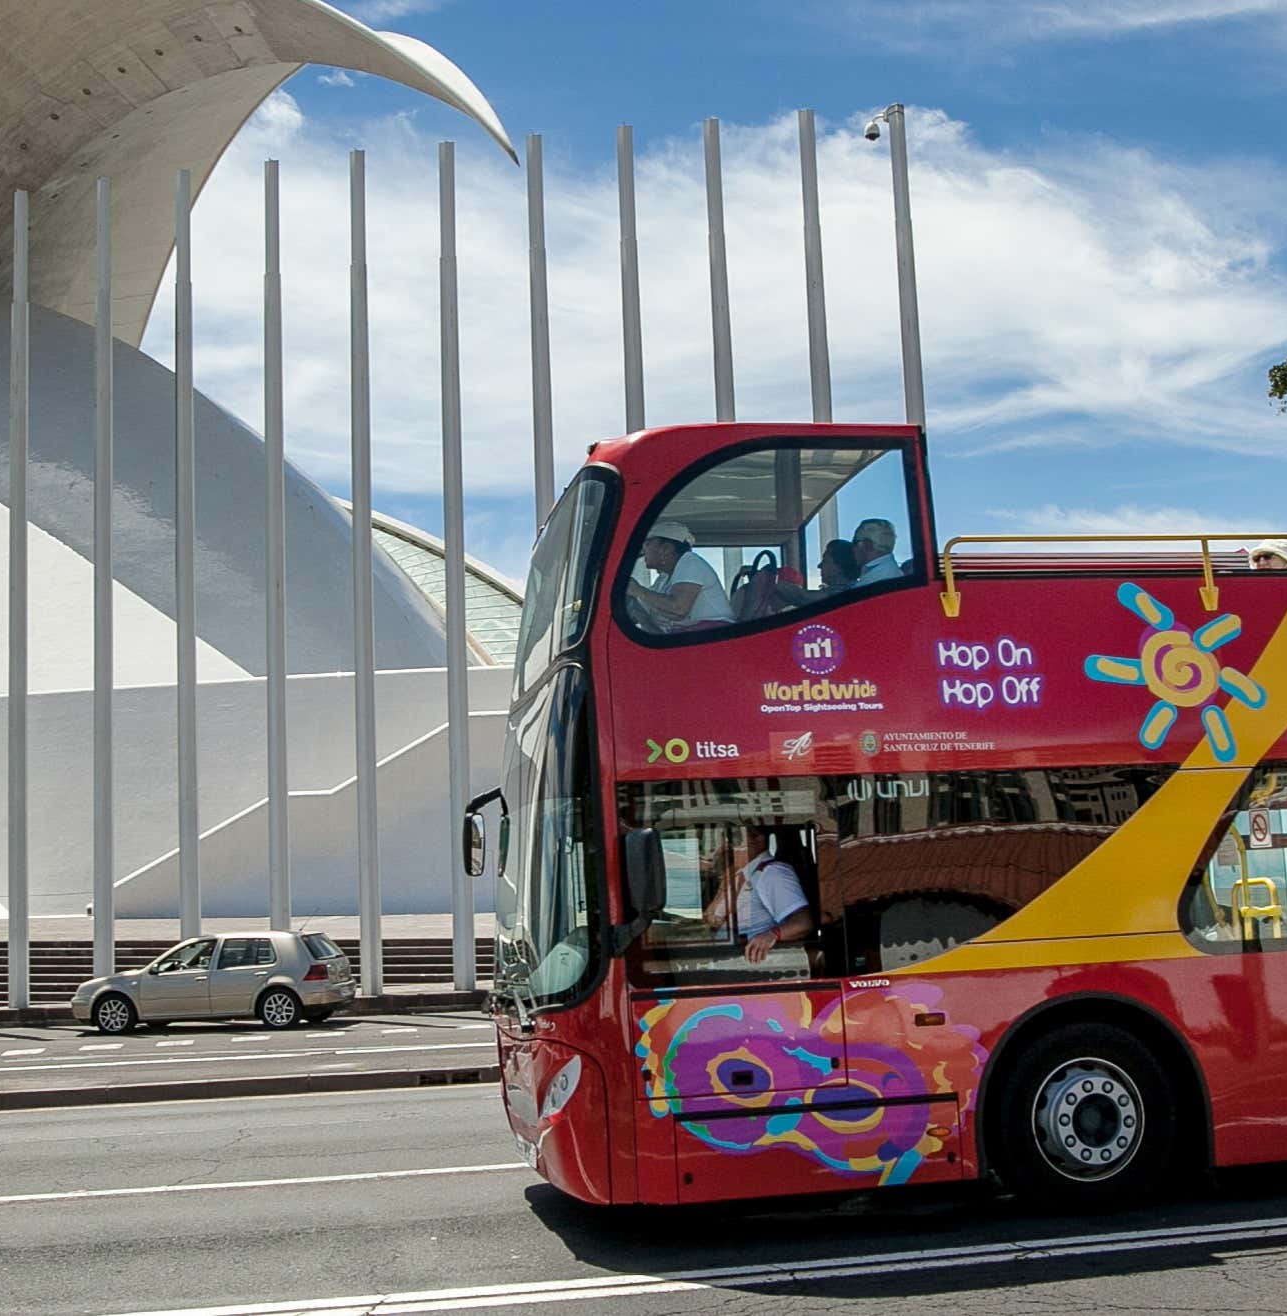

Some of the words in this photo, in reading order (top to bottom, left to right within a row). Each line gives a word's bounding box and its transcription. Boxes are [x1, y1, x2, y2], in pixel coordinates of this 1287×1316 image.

[938, 642, 990, 671] Hop
[998, 639, 1032, 667] On
[763, 679, 877, 701] Worldwide
[943, 680, 994, 708] Hop
[1002, 676, 1041, 704] Off
[760, 704, 802, 713] OpenTop
[803, 703, 857, 712] Sightseeing
[858, 702, 884, 710] Tours
[883, 731, 954, 741] AYUNTAMIENTO
[955, 731, 968, 740] DE
[695, 741, 740, 758] titsa
[883, 743, 913, 752] SANTA
[914, 743, 938, 752] CRUZ
[940, 743, 953, 751] DE
[954, 742, 996, 751] TENERIFE
[849, 980, 890, 988] VOLVO
